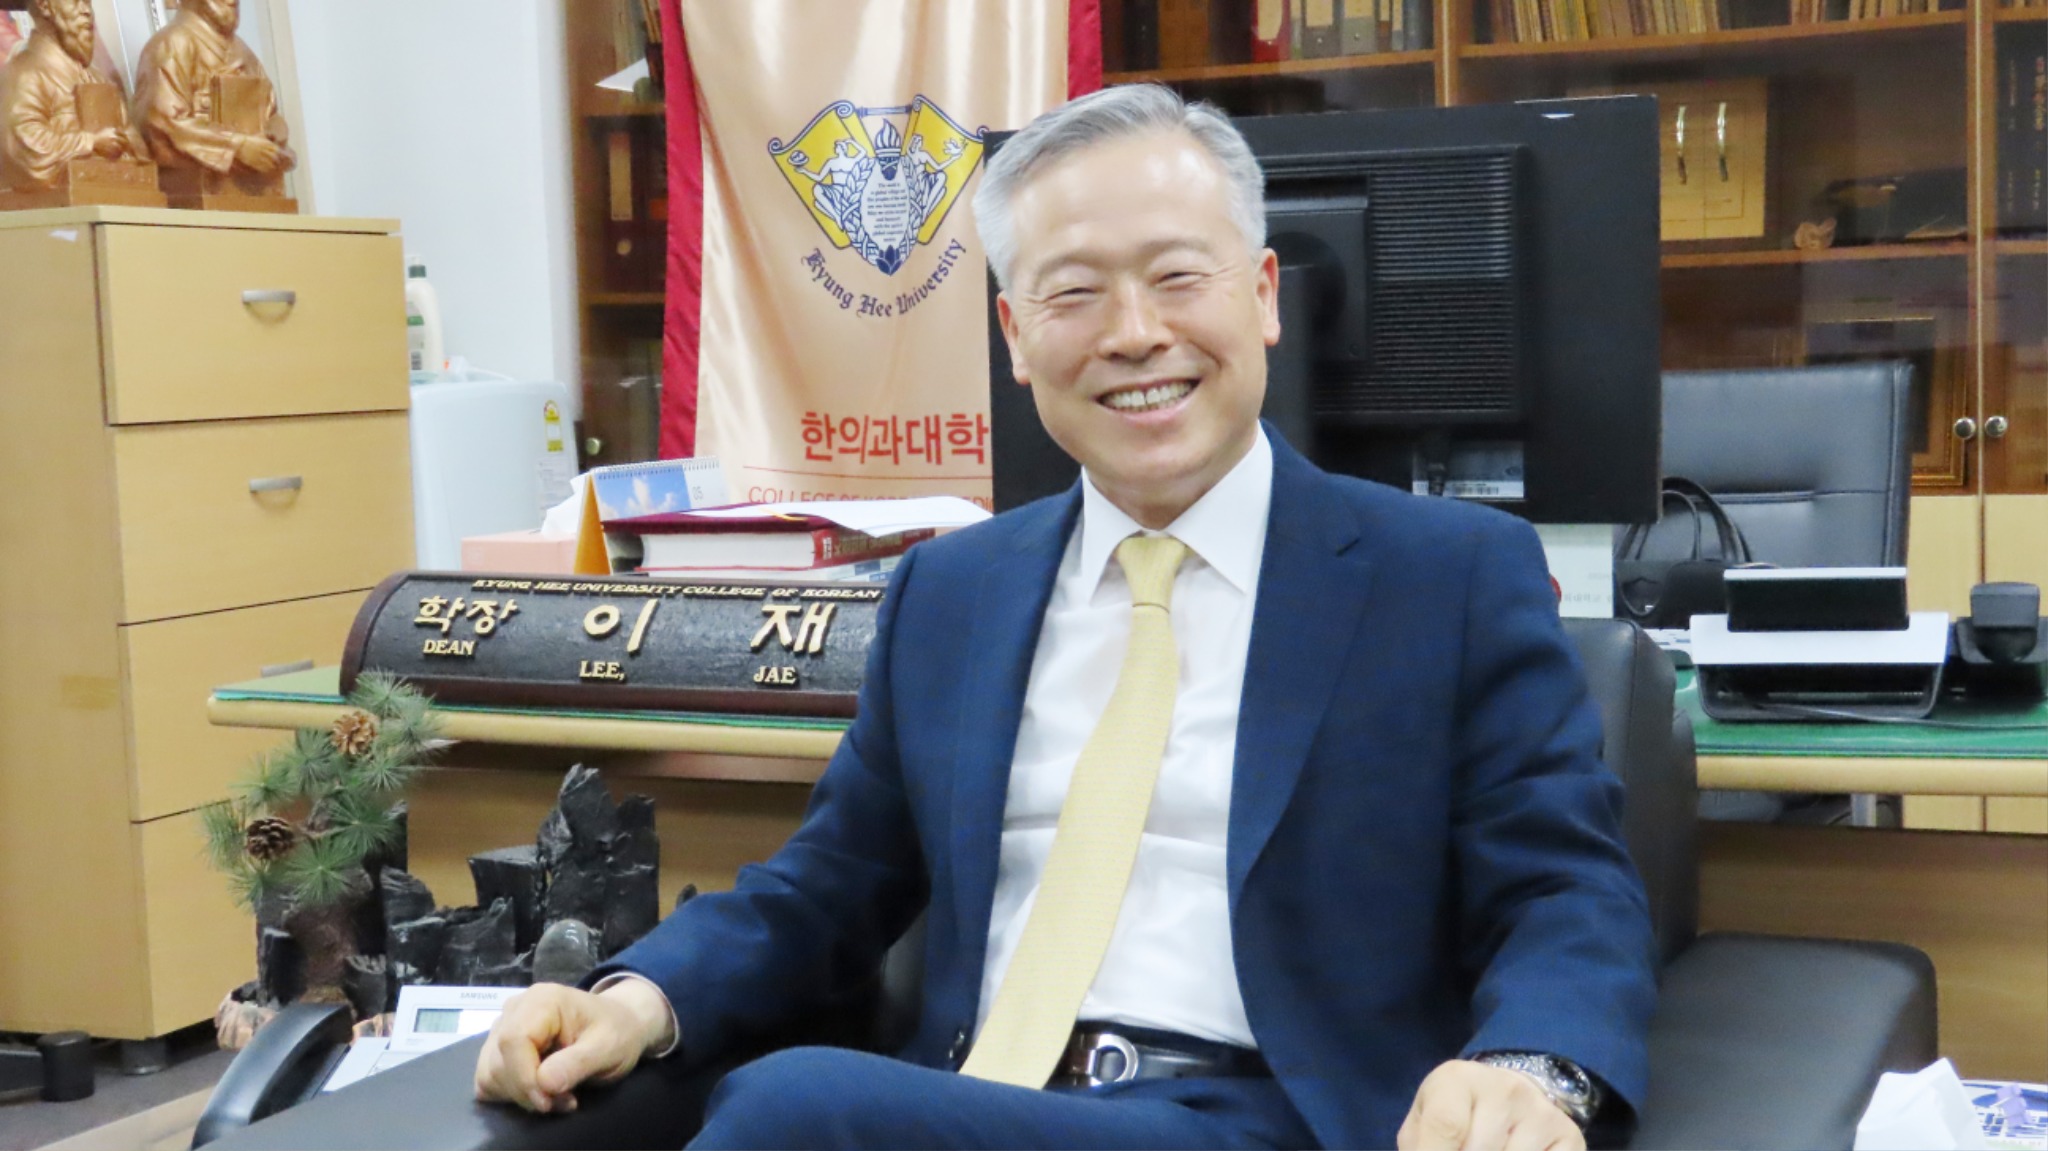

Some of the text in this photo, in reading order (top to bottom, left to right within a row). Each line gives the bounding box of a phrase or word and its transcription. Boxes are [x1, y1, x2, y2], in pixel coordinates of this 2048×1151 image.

[801, 238, 966, 318] Kyung Hee University
[801, 411, 989, 465] 한의과대학
[472, 579, 532, 589] KYUNG
[534, 581, 571, 590] HEE
[572, 583, 682, 594] UNIVERSITY
[683, 586, 767, 596] COLLEGE
[771, 587, 798, 597] OF
[801, 589, 881, 598] KOREAN
[414, 596, 836, 654] 학장 이 재
[423, 639, 476, 656] DEAN
[579, 660, 797, 684] LEE, JAE
[460, 992, 499, 1000] SAMSUNG
